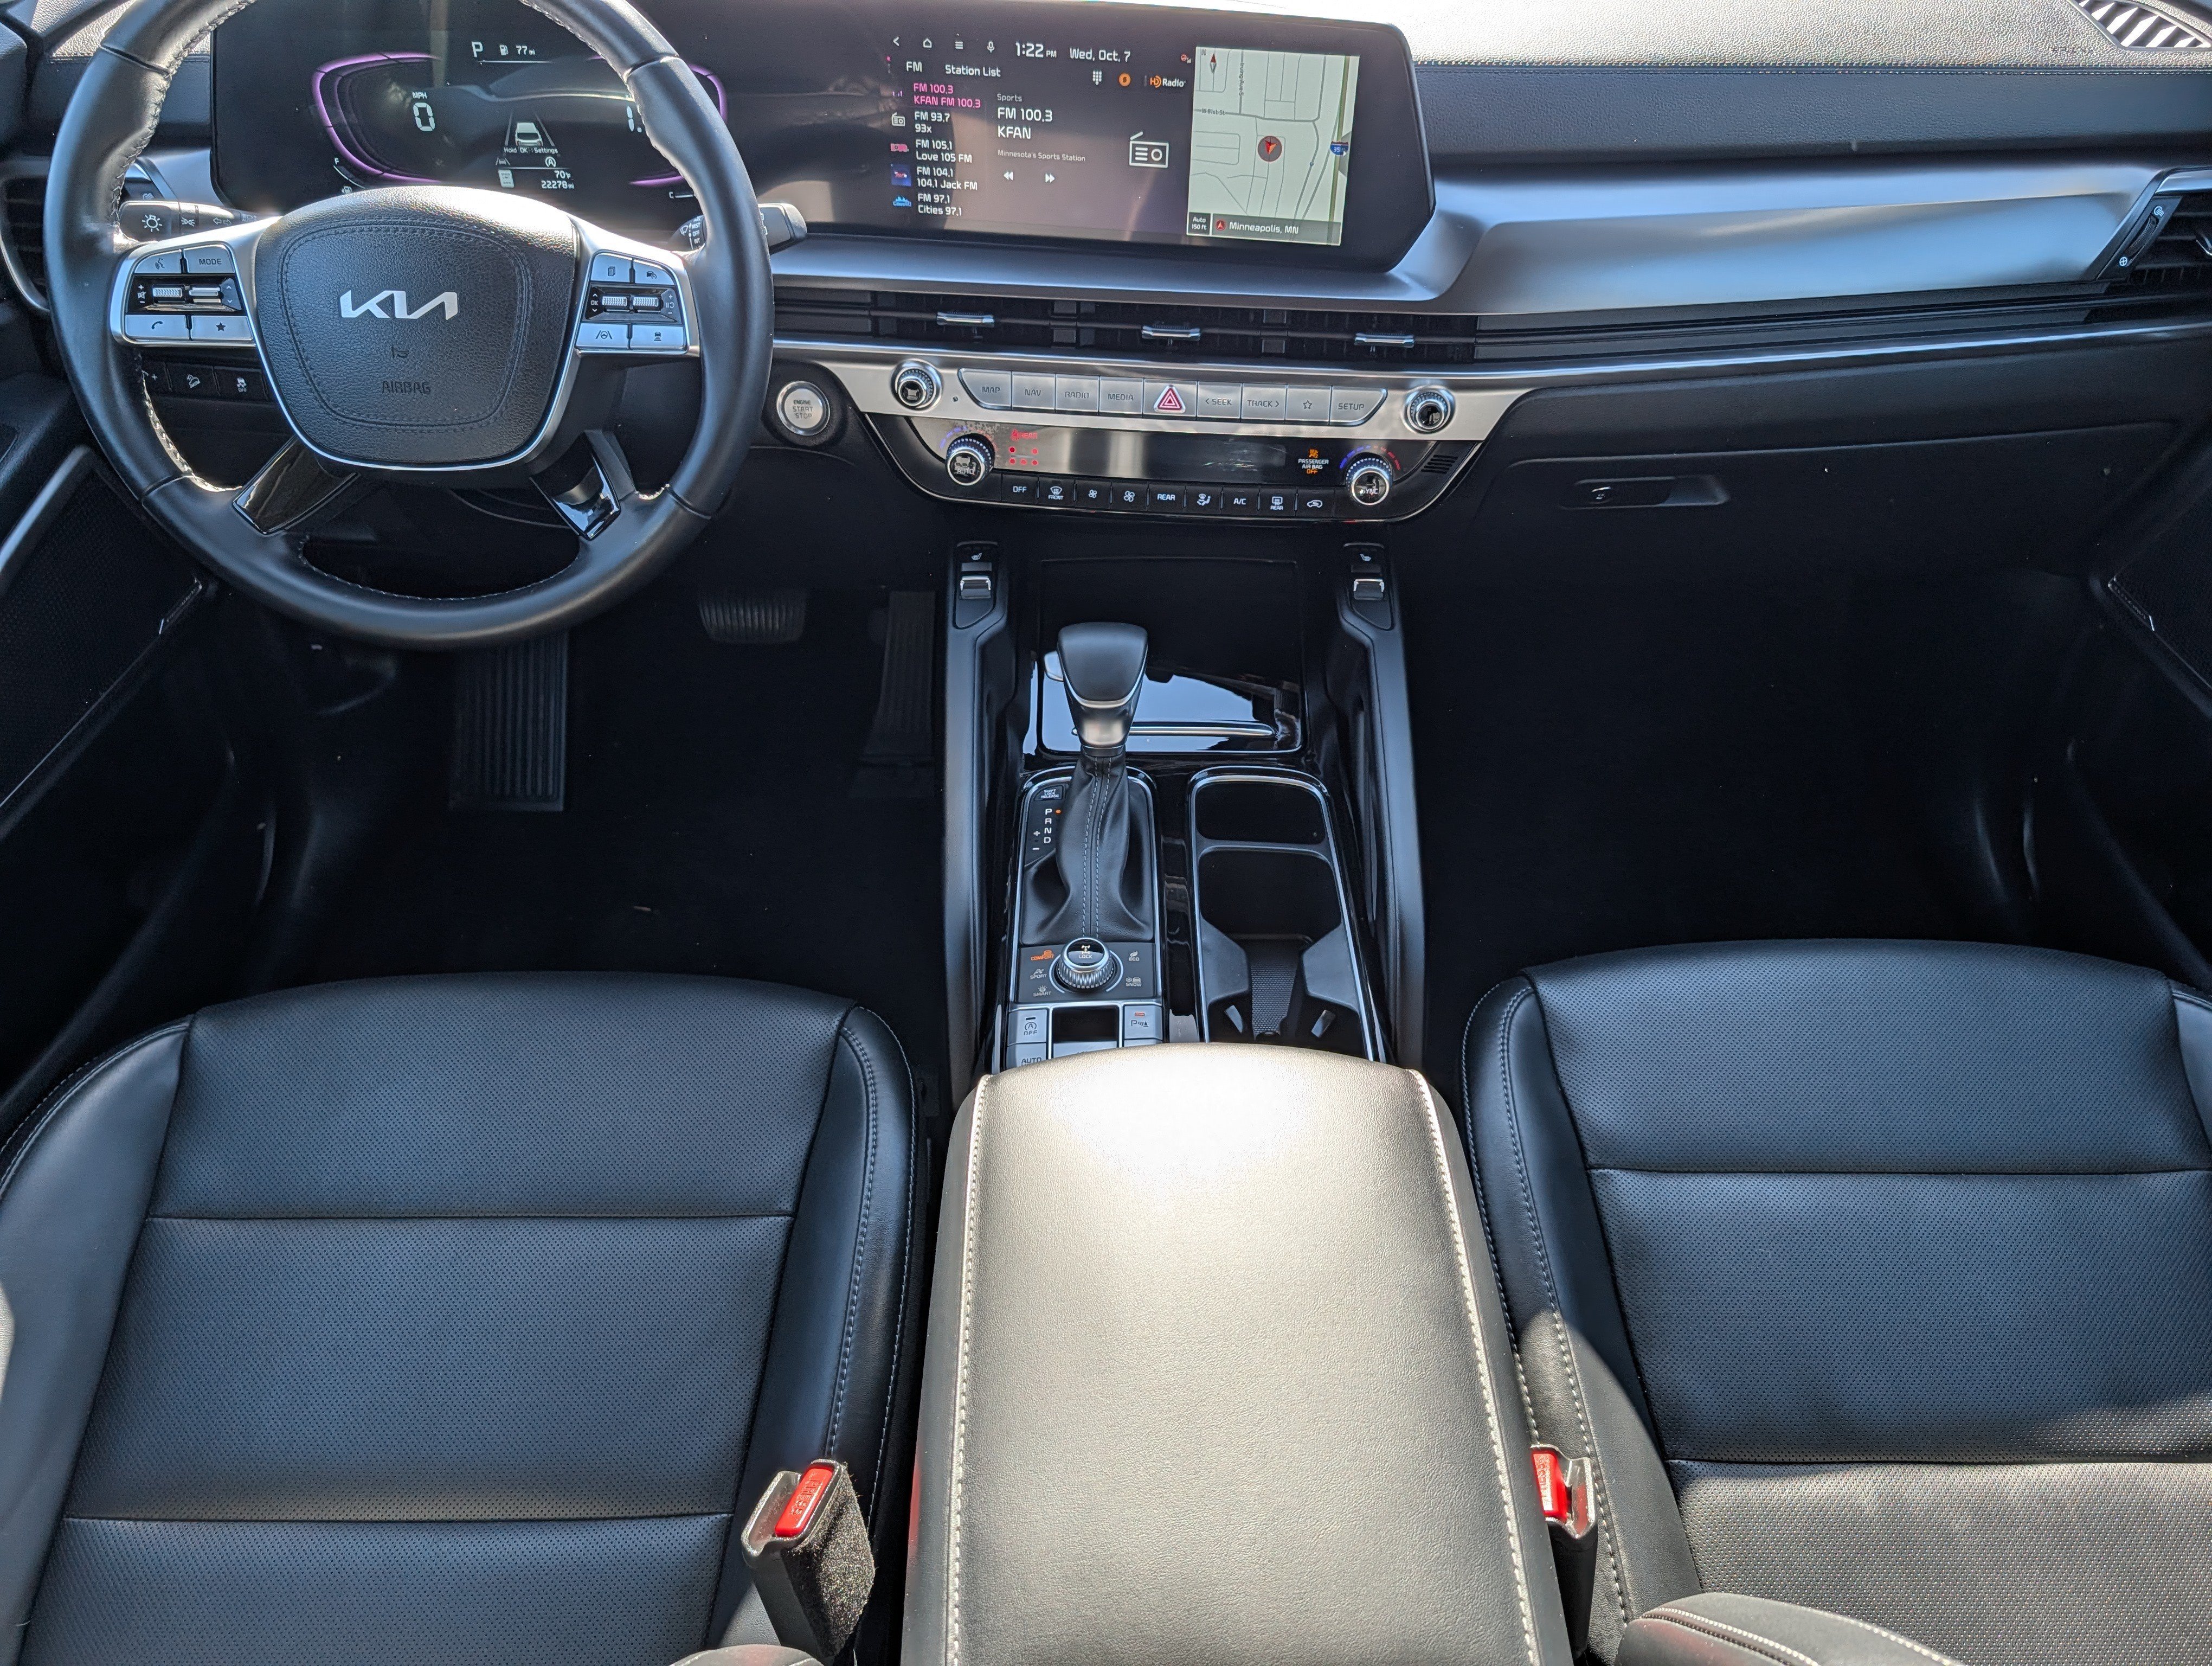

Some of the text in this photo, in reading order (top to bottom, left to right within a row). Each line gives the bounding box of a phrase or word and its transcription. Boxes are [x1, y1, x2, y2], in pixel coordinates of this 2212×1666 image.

[471, 41, 483, 57] P
[516, 45, 528, 55] 77
[1015, 42, 1057, 58] 1:22 PM
[1070, 48, 1131, 62] Wed. Oct. 7
[906, 61, 922, 73] FM
[945, 64, 1001, 77] Station List
[913, 83, 954, 94] FM 100.3
[412, 91, 427, 99] MPH
[997, 94, 1022, 103] Sports
[914, 95, 981, 108] KFAN FM 100.3
[413, 102, 435, 131] 0
[914, 111, 950, 123] FM 93.7
[997, 107, 1053, 123] FM 100.3
[915, 124, 932, 133] 93x
[997, 126, 1031, 139] KFAN
[916, 139, 929, 149] FM
[931, 140, 953, 150] 105.1
[916, 151, 972, 163] Love 105 FM
[997, 149, 1085, 162] Minnesota's Sports Station
[916, 166, 930, 176] FM
[933, 168, 953, 177] 104.1
[917, 178, 978, 190] 104.1 Jack FM
[917, 193, 950, 204] FM 97.1
[918, 205, 962, 216] Cities 97.1
[1229, 222, 1299, 234] Minneapolis, MN
[381, 381, 432, 394] AIRBAG
[1065, 391, 1089, 399] RADIO
[1108, 393, 1134, 401] MEDIA
[790, 1479, 820, 1515] PRESS
